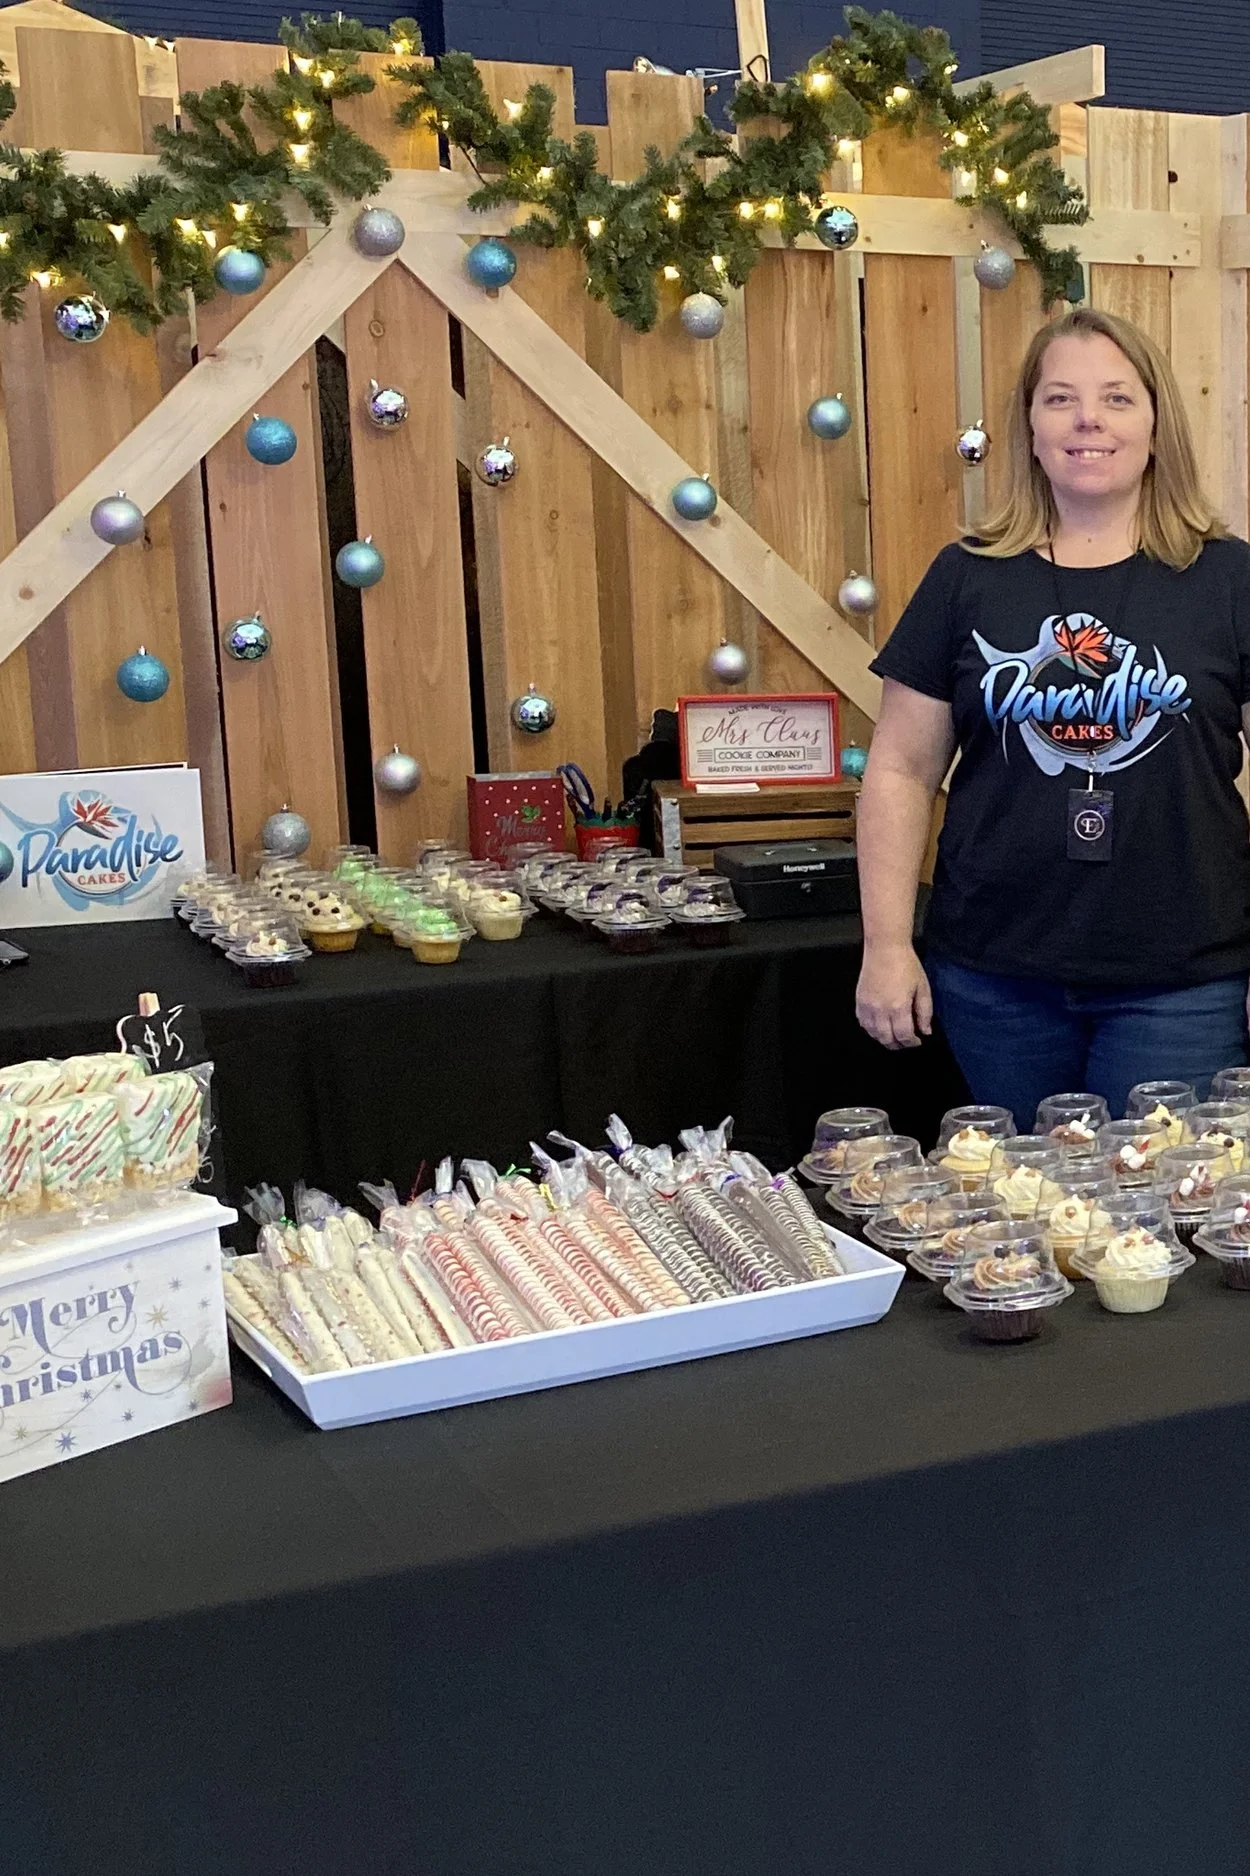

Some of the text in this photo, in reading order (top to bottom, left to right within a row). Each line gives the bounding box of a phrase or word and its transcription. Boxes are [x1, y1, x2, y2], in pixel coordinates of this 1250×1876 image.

[980, 644, 1193, 741] Paradise
[696, 716, 820, 746] Mrs Claus
[1051, 724, 1115, 740] CAKES
[718, 750, 801, 760] COOKIE COMPANY
[17, 815, 184, 888] Paradise
[783, 862, 825, 873] Honeywell
[77, 872, 126, 886] CAKES
[142, 1004, 186, 1069] $5
[0, 1281, 140, 1356] Merry
[0, 1330, 184, 1408] ristmas
